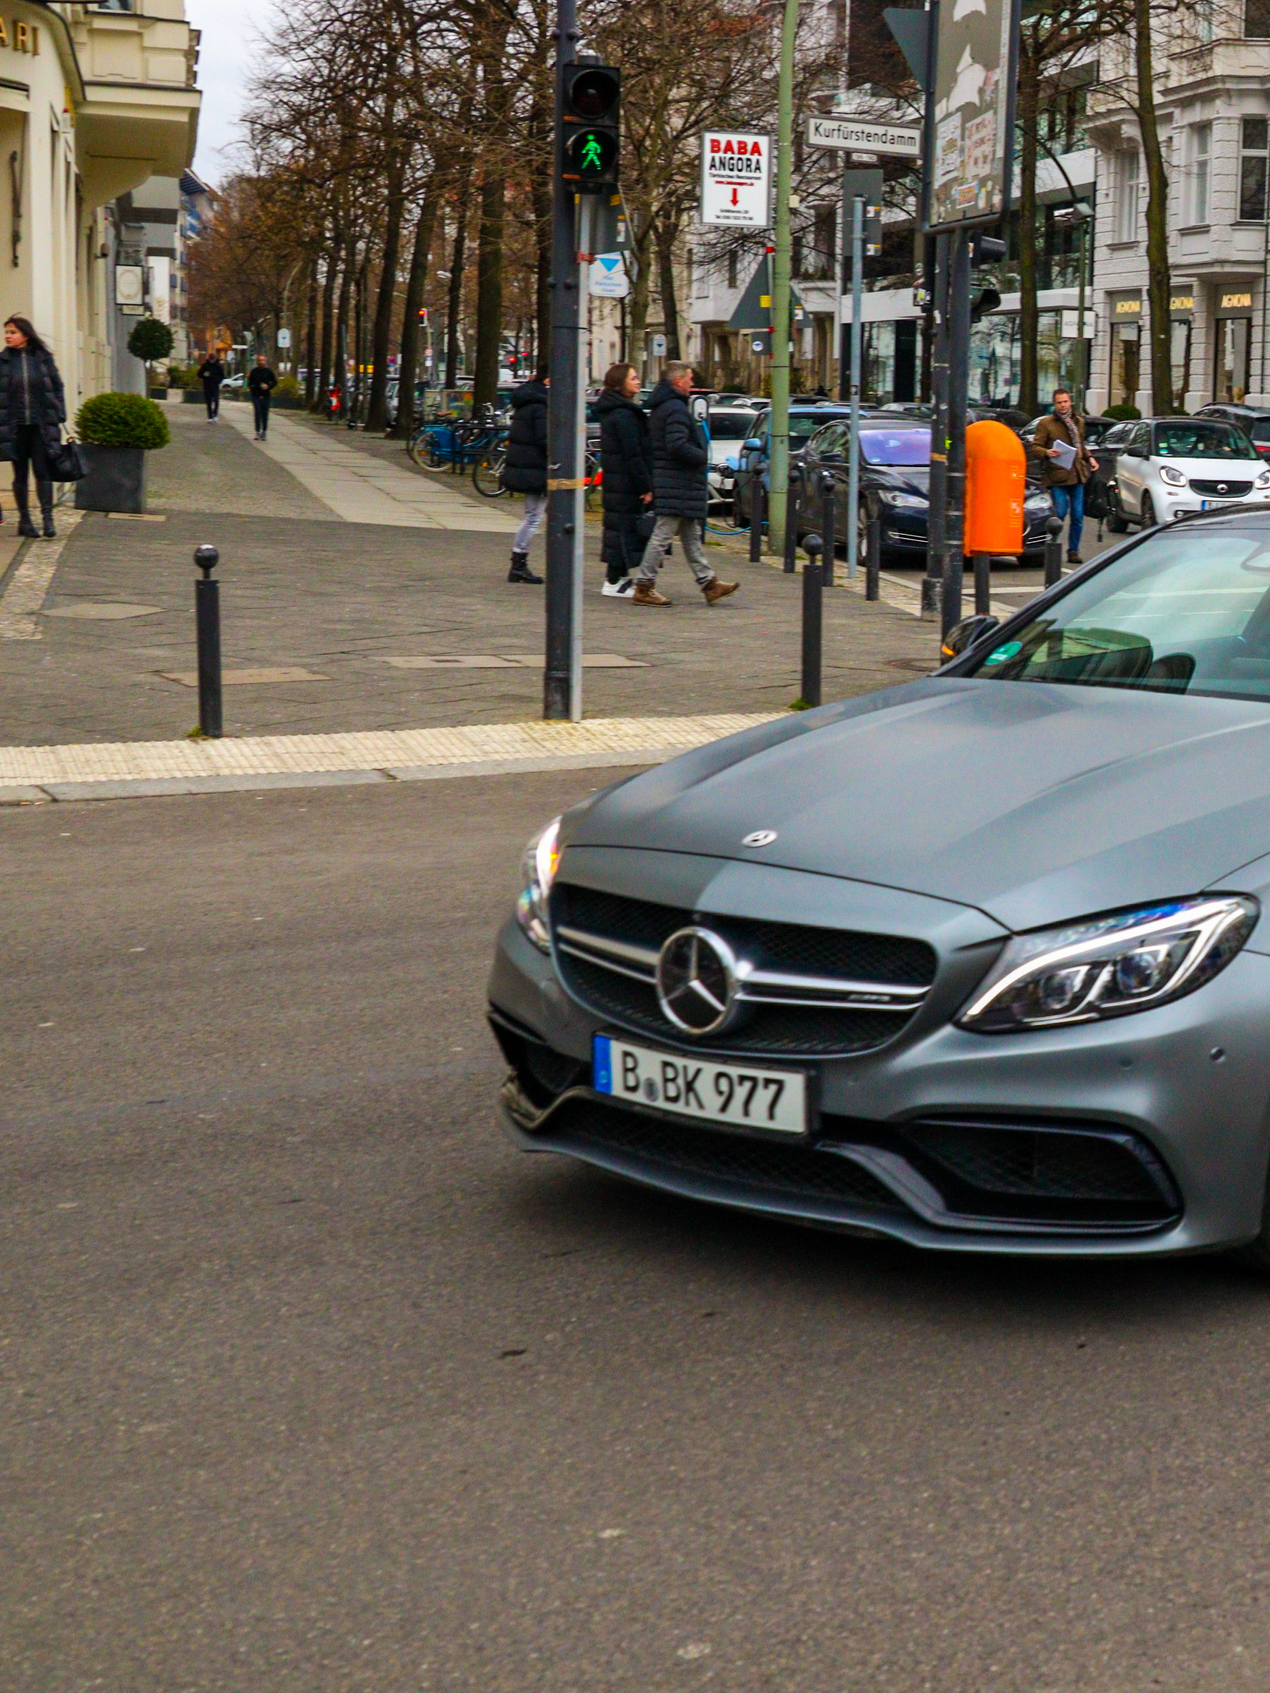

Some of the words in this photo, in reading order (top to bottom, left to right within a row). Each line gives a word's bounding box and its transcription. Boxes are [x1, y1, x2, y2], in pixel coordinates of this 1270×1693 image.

[814, 121, 917, 147] Kurfürstendamm
[710, 138, 762, 156] BABA
[709, 155, 761, 173] ANGORA
[1170, 296, 1193, 310] GNONA
[622, 1050, 640, 1093] B
[661, 1060, 705, 1110] BK
[714, 1071, 785, 1121] 977
